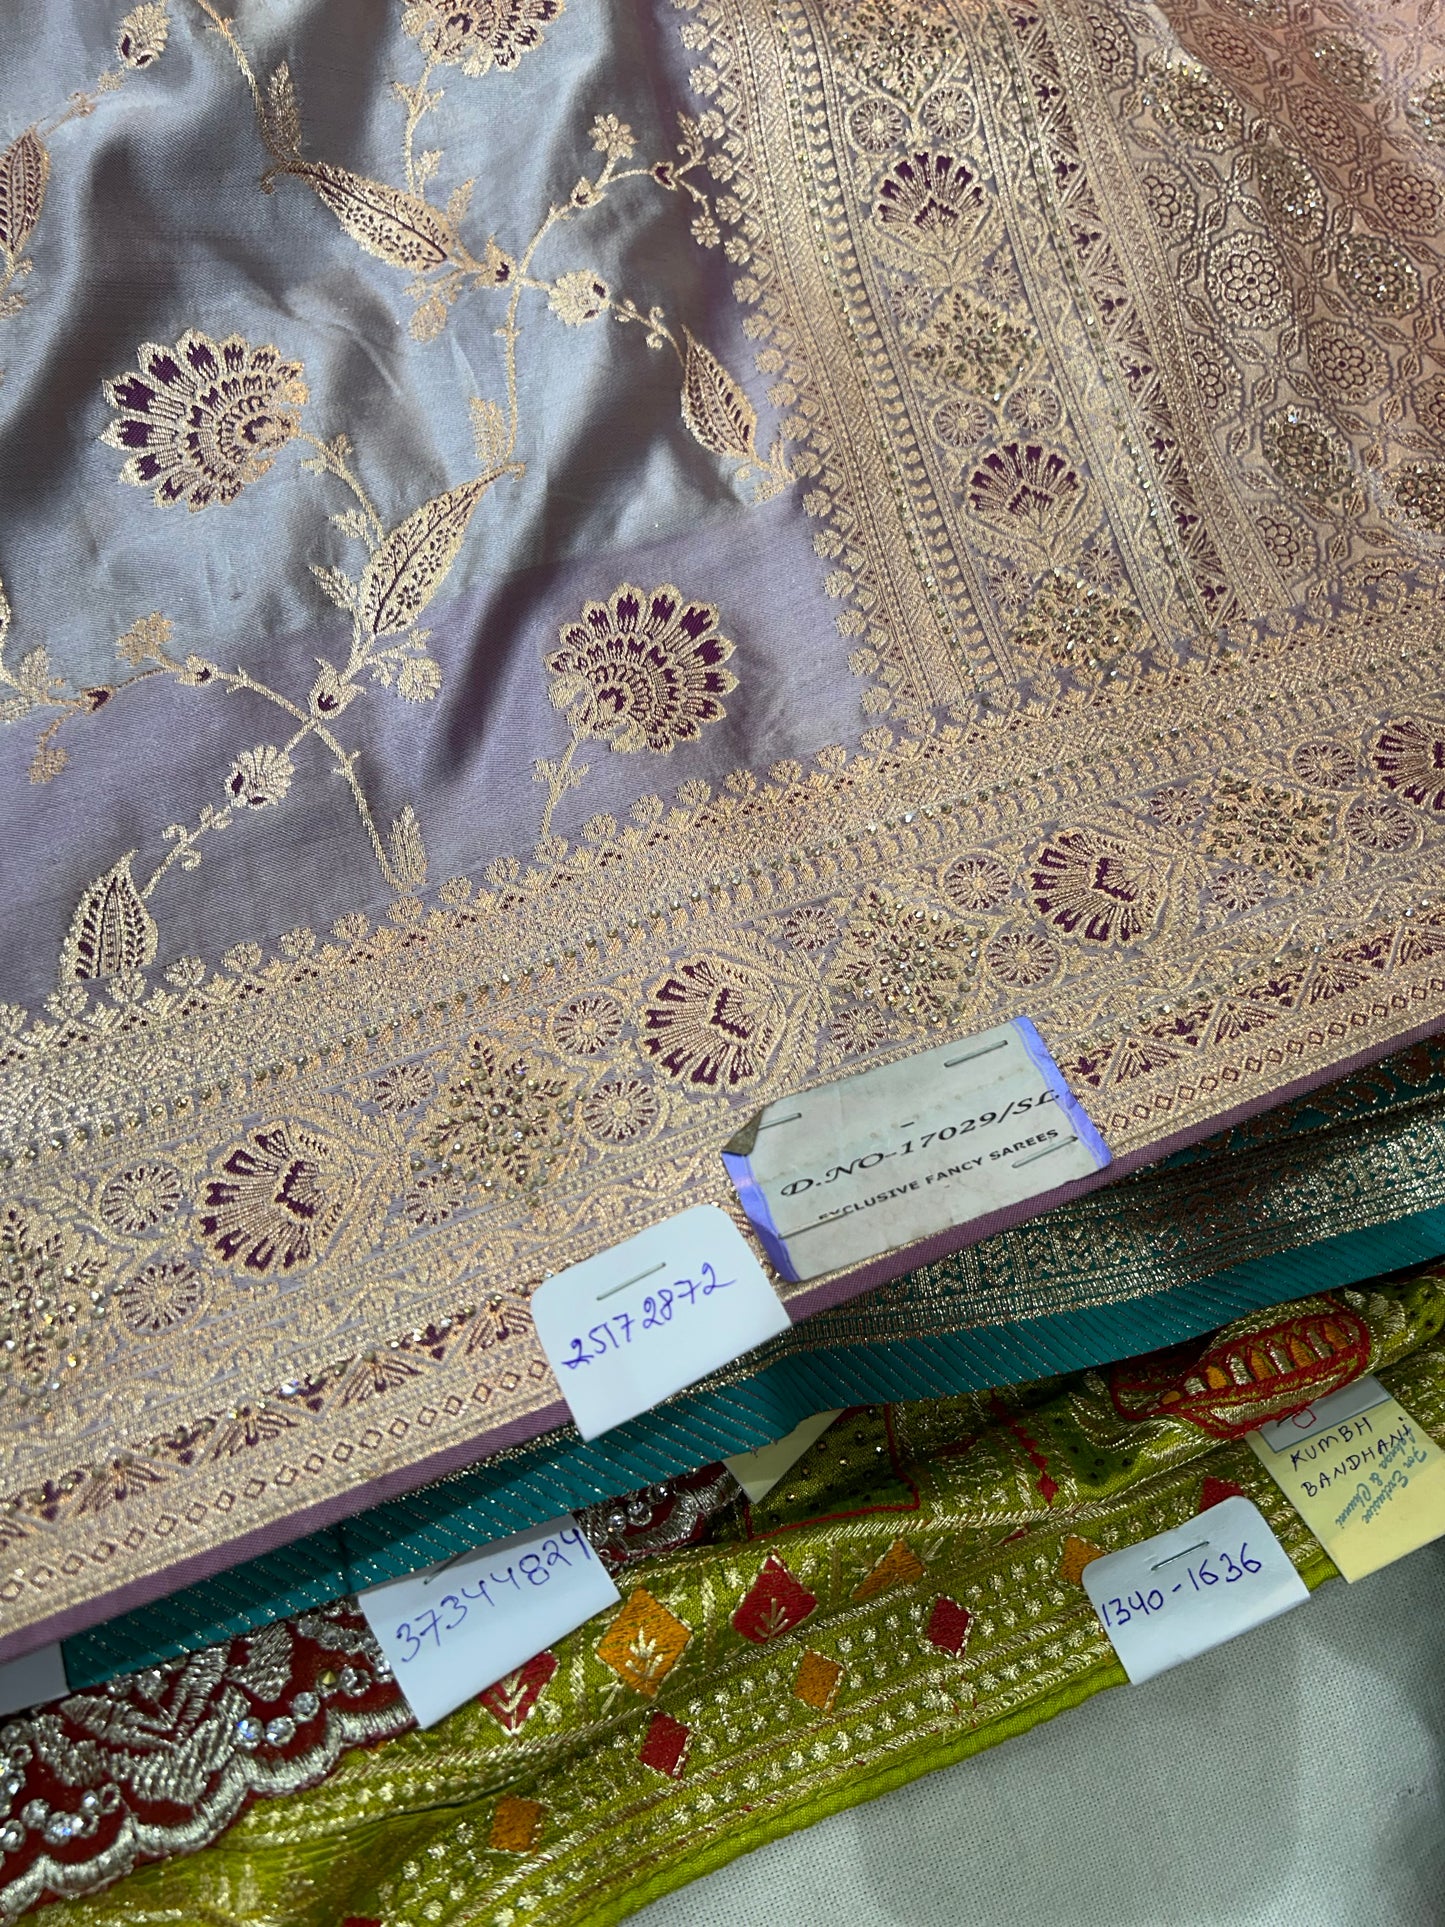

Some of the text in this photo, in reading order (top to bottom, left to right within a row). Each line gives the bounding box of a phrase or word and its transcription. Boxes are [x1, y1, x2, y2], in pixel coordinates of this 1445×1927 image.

[925, 1157, 983, 1185] FANCY
[989, 1129, 1059, 1161] SAREES
[1290, 1416, 1373, 1472] KUMBH
[1335, 1482, 1372, 1529] Chunni
[1361, 1446, 1428, 1525] For Exclusive
[1369, 1471, 1384, 1487] &
[396, 1527, 592, 1663] 37344824
